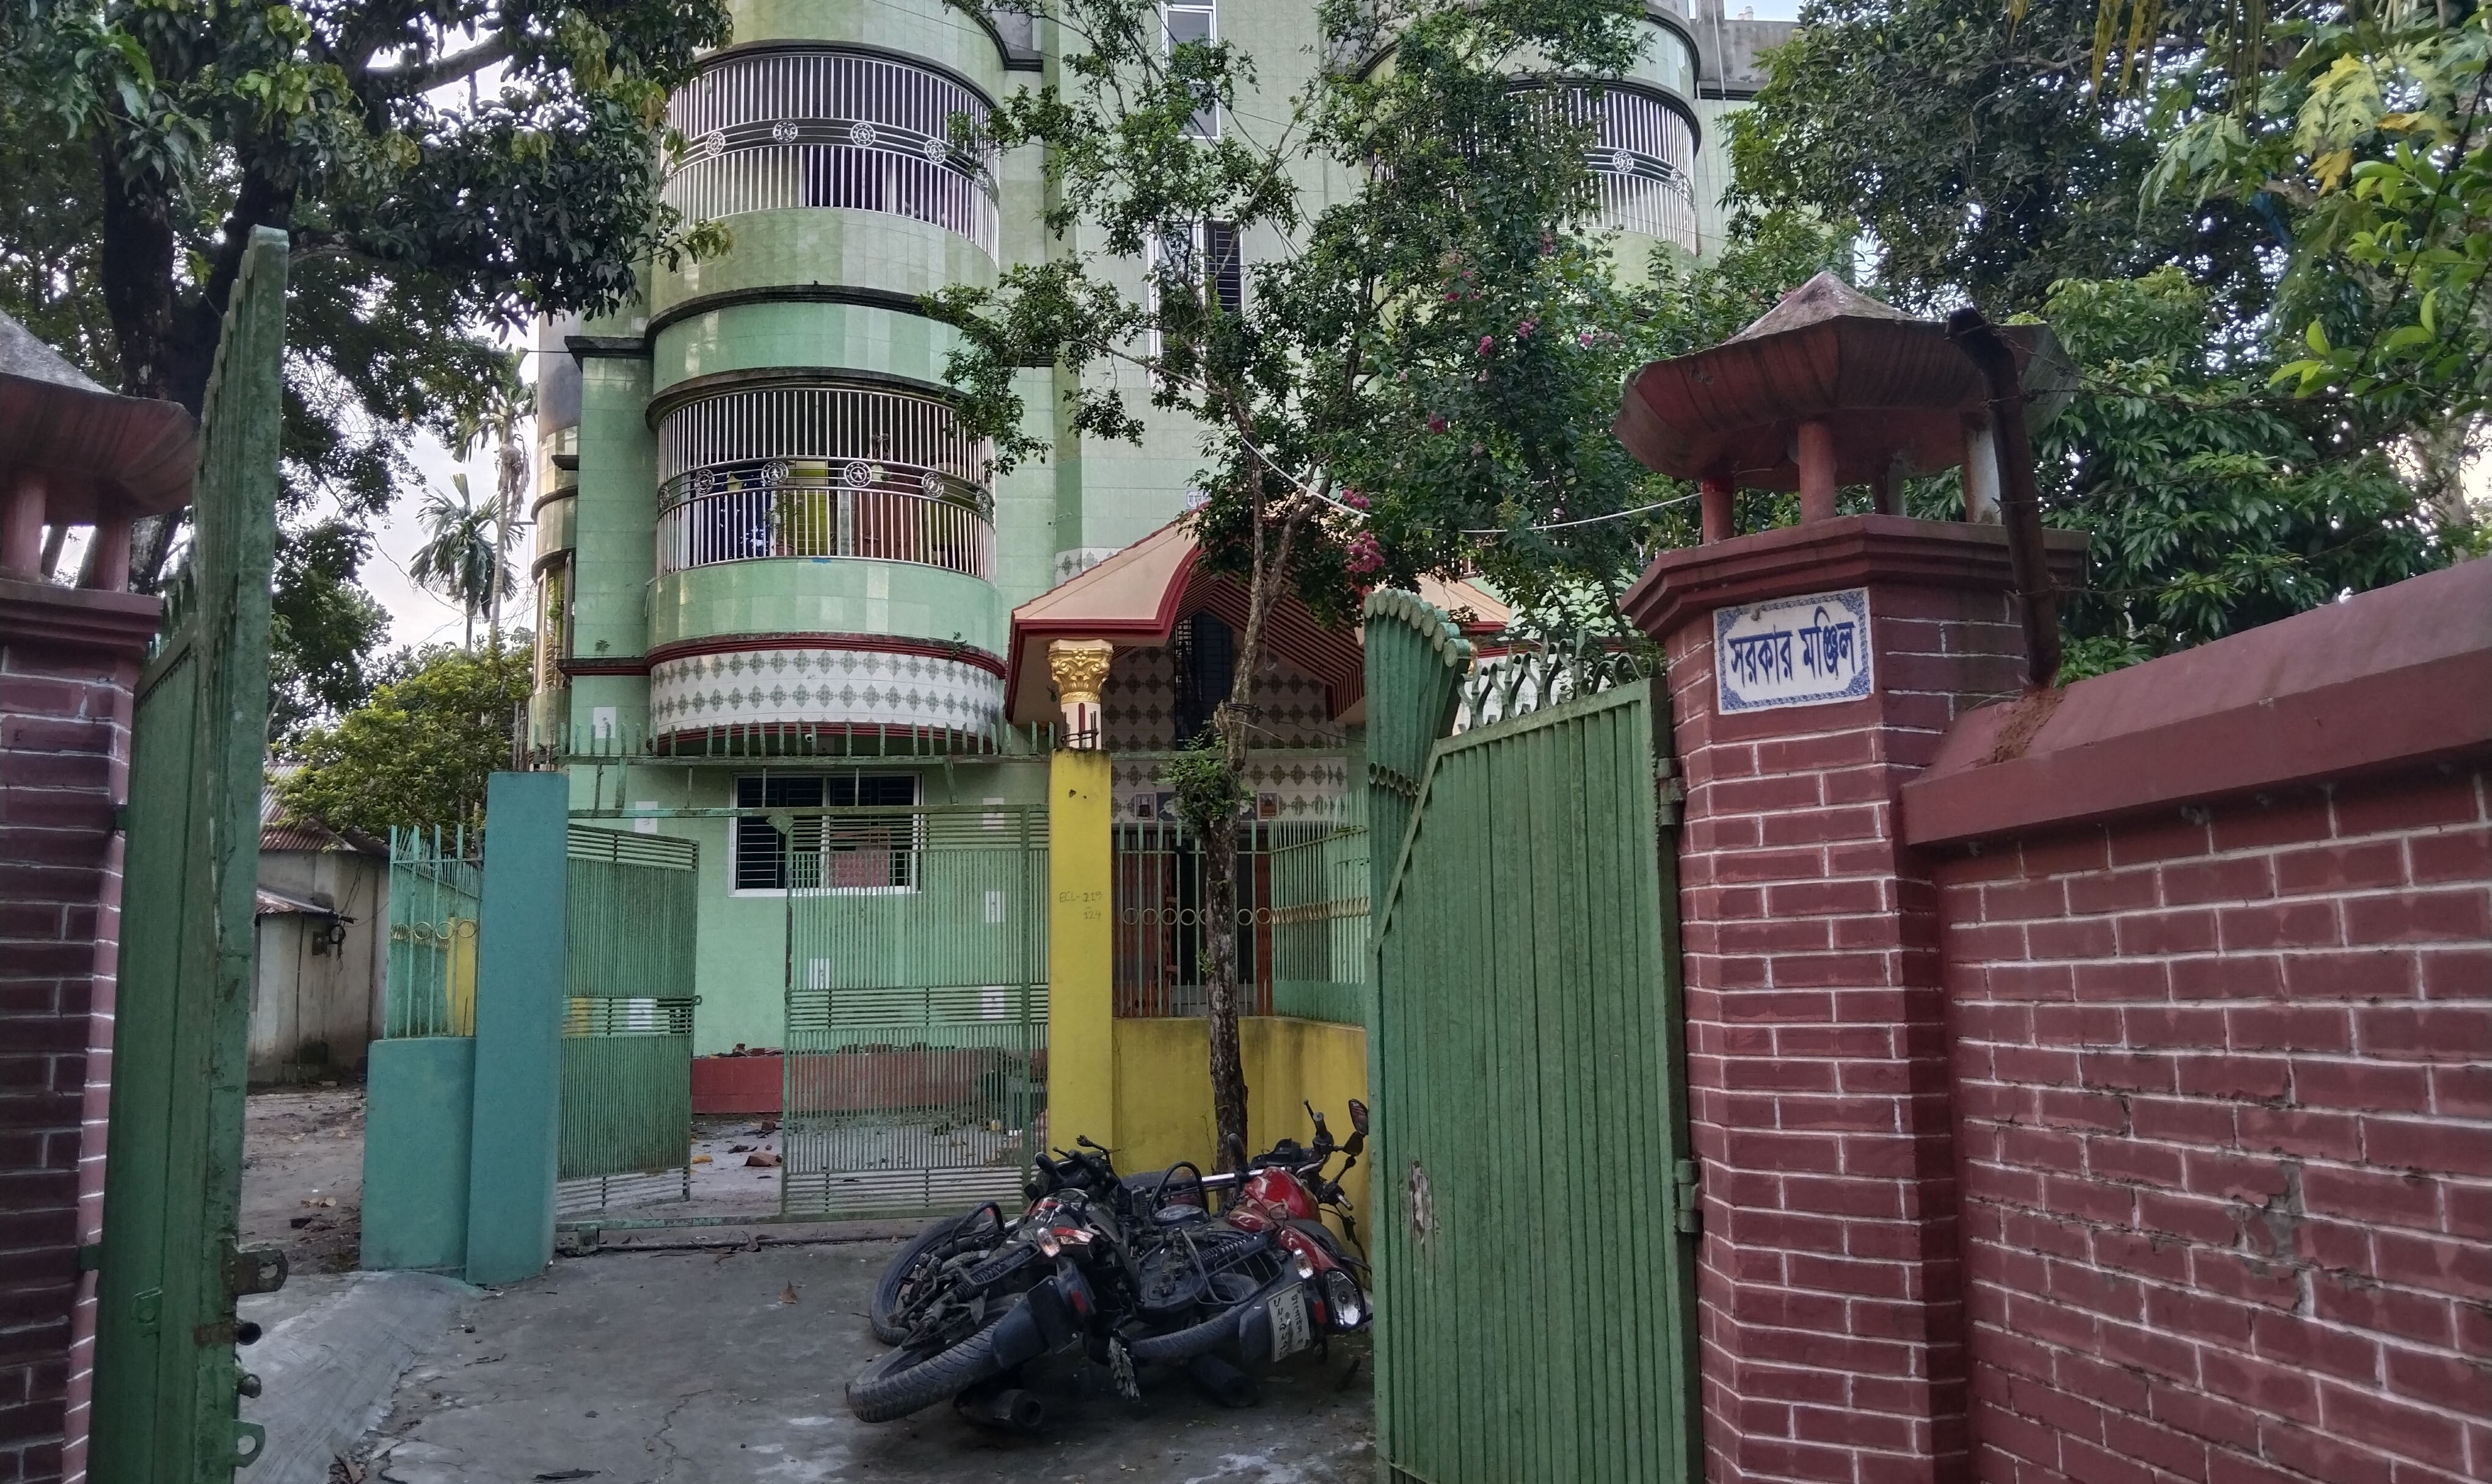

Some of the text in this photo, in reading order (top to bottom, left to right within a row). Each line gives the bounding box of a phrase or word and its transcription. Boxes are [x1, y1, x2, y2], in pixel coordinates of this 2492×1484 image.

[1727, 606, 1856, 688] সরকার মঞ্জিল
[1084, 911, 1101, 922] 124
